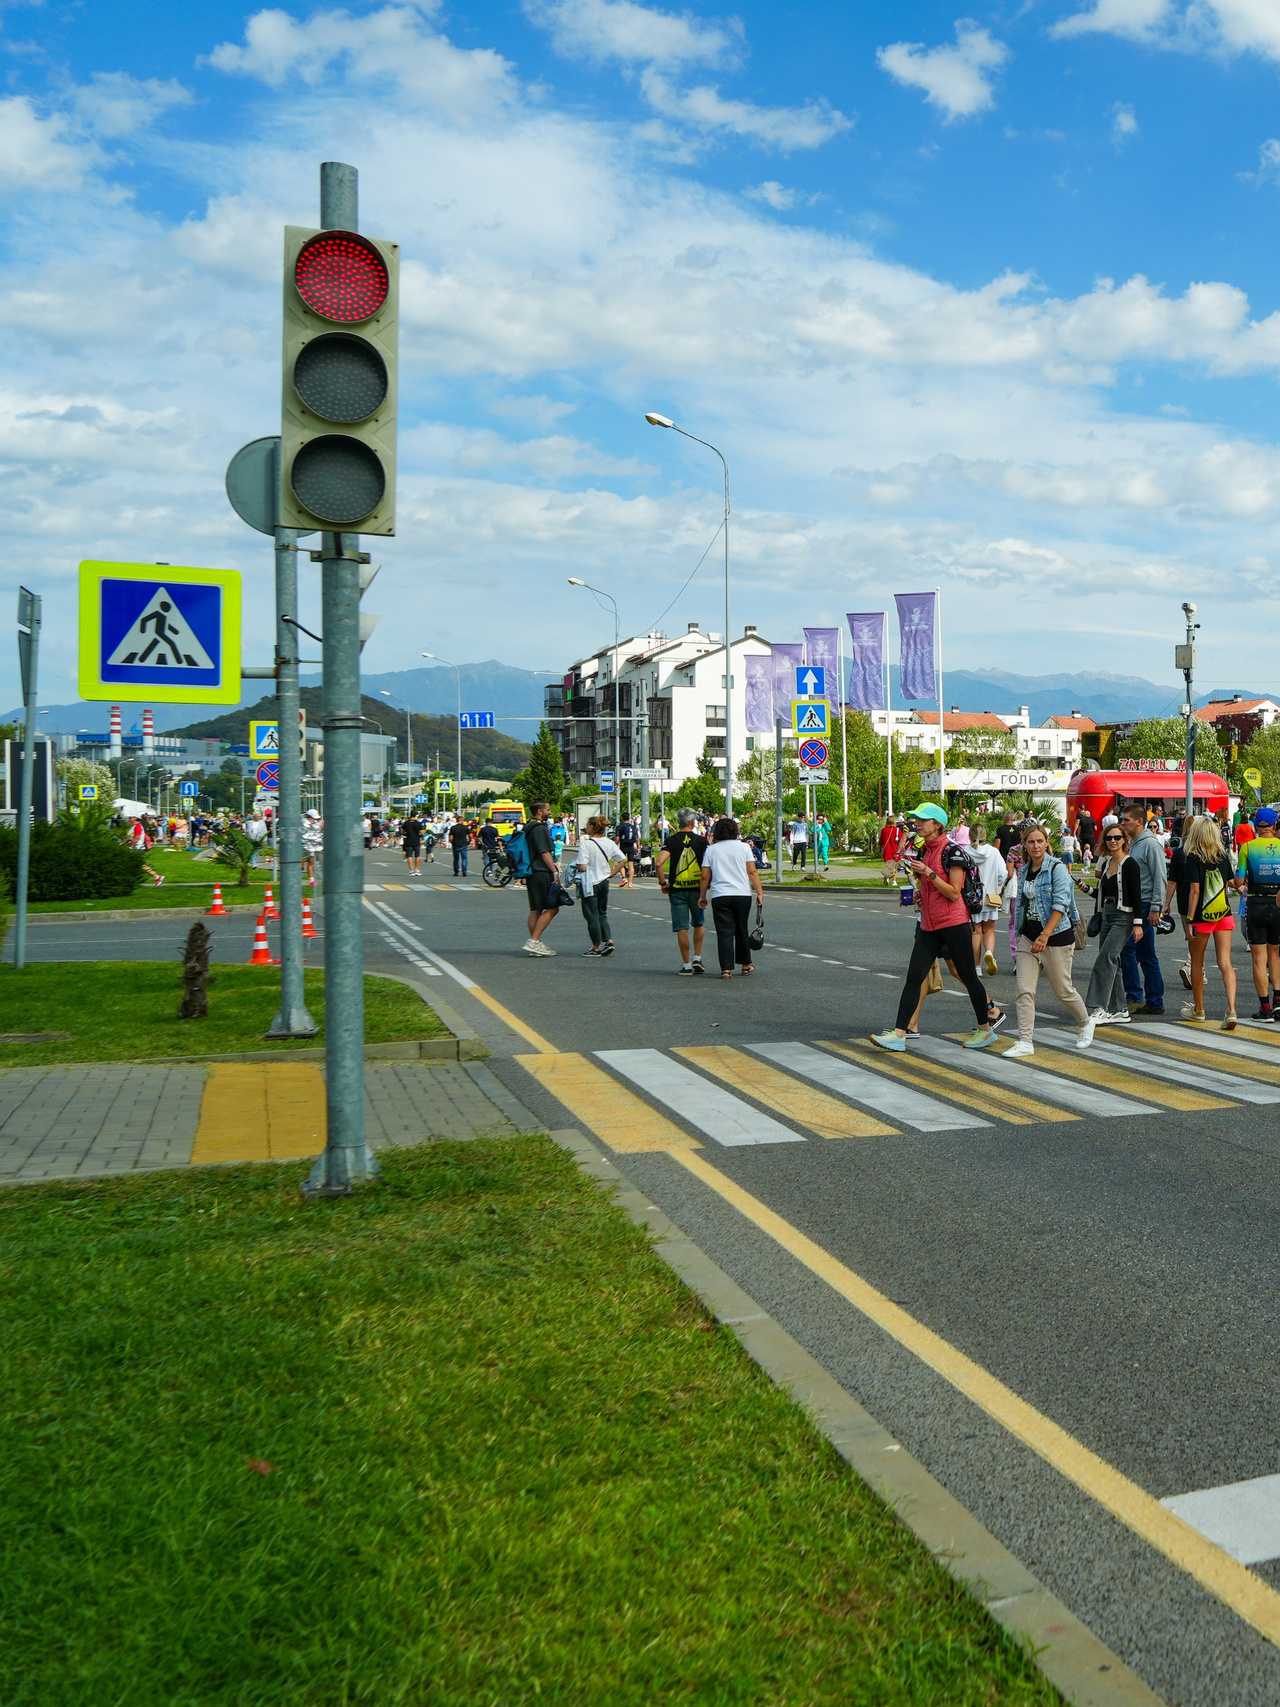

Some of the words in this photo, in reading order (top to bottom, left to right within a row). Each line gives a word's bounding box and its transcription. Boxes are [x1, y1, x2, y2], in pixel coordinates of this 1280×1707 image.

[1119, 759, 1137, 770] ZA
[1001, 774, 1048, 785] ГОЛЬФ
[675, 879, 701, 887] OLYMPI
